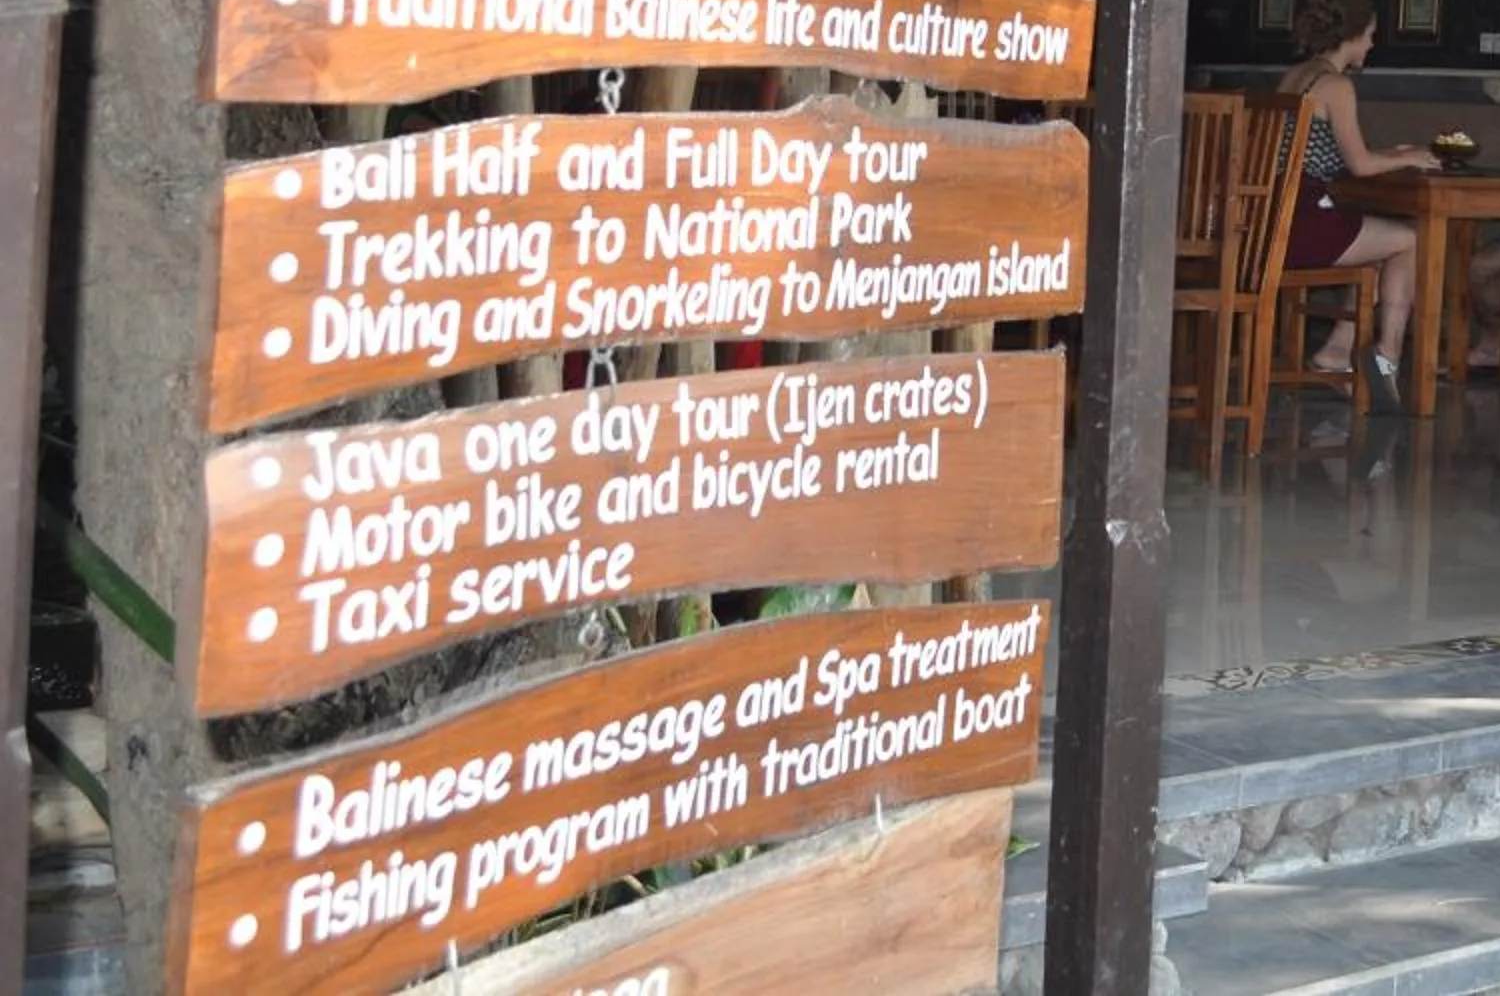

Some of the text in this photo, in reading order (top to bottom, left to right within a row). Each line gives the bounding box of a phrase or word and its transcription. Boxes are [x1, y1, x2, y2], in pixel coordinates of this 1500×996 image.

[887, 2, 989, 59] culture
[991, 22, 1072, 66] show
[320, 125, 929, 209] Bali Half and Full Day tour
[307, 237, 1071, 367] Diving and Snorkeling to Menjangan island
[318, 191, 913, 290] Trekking to National Park
[302, 357, 989, 499] Java one day tour (Ijen crates)
[300, 427, 940, 577] Motor bike and bicycle rental
[297, 539, 635, 655] Taxi service
[292, 603, 1042, 859] Balinese massage and Spa treatment
[283, 672, 1032, 954] Fishing program with traditional boat
